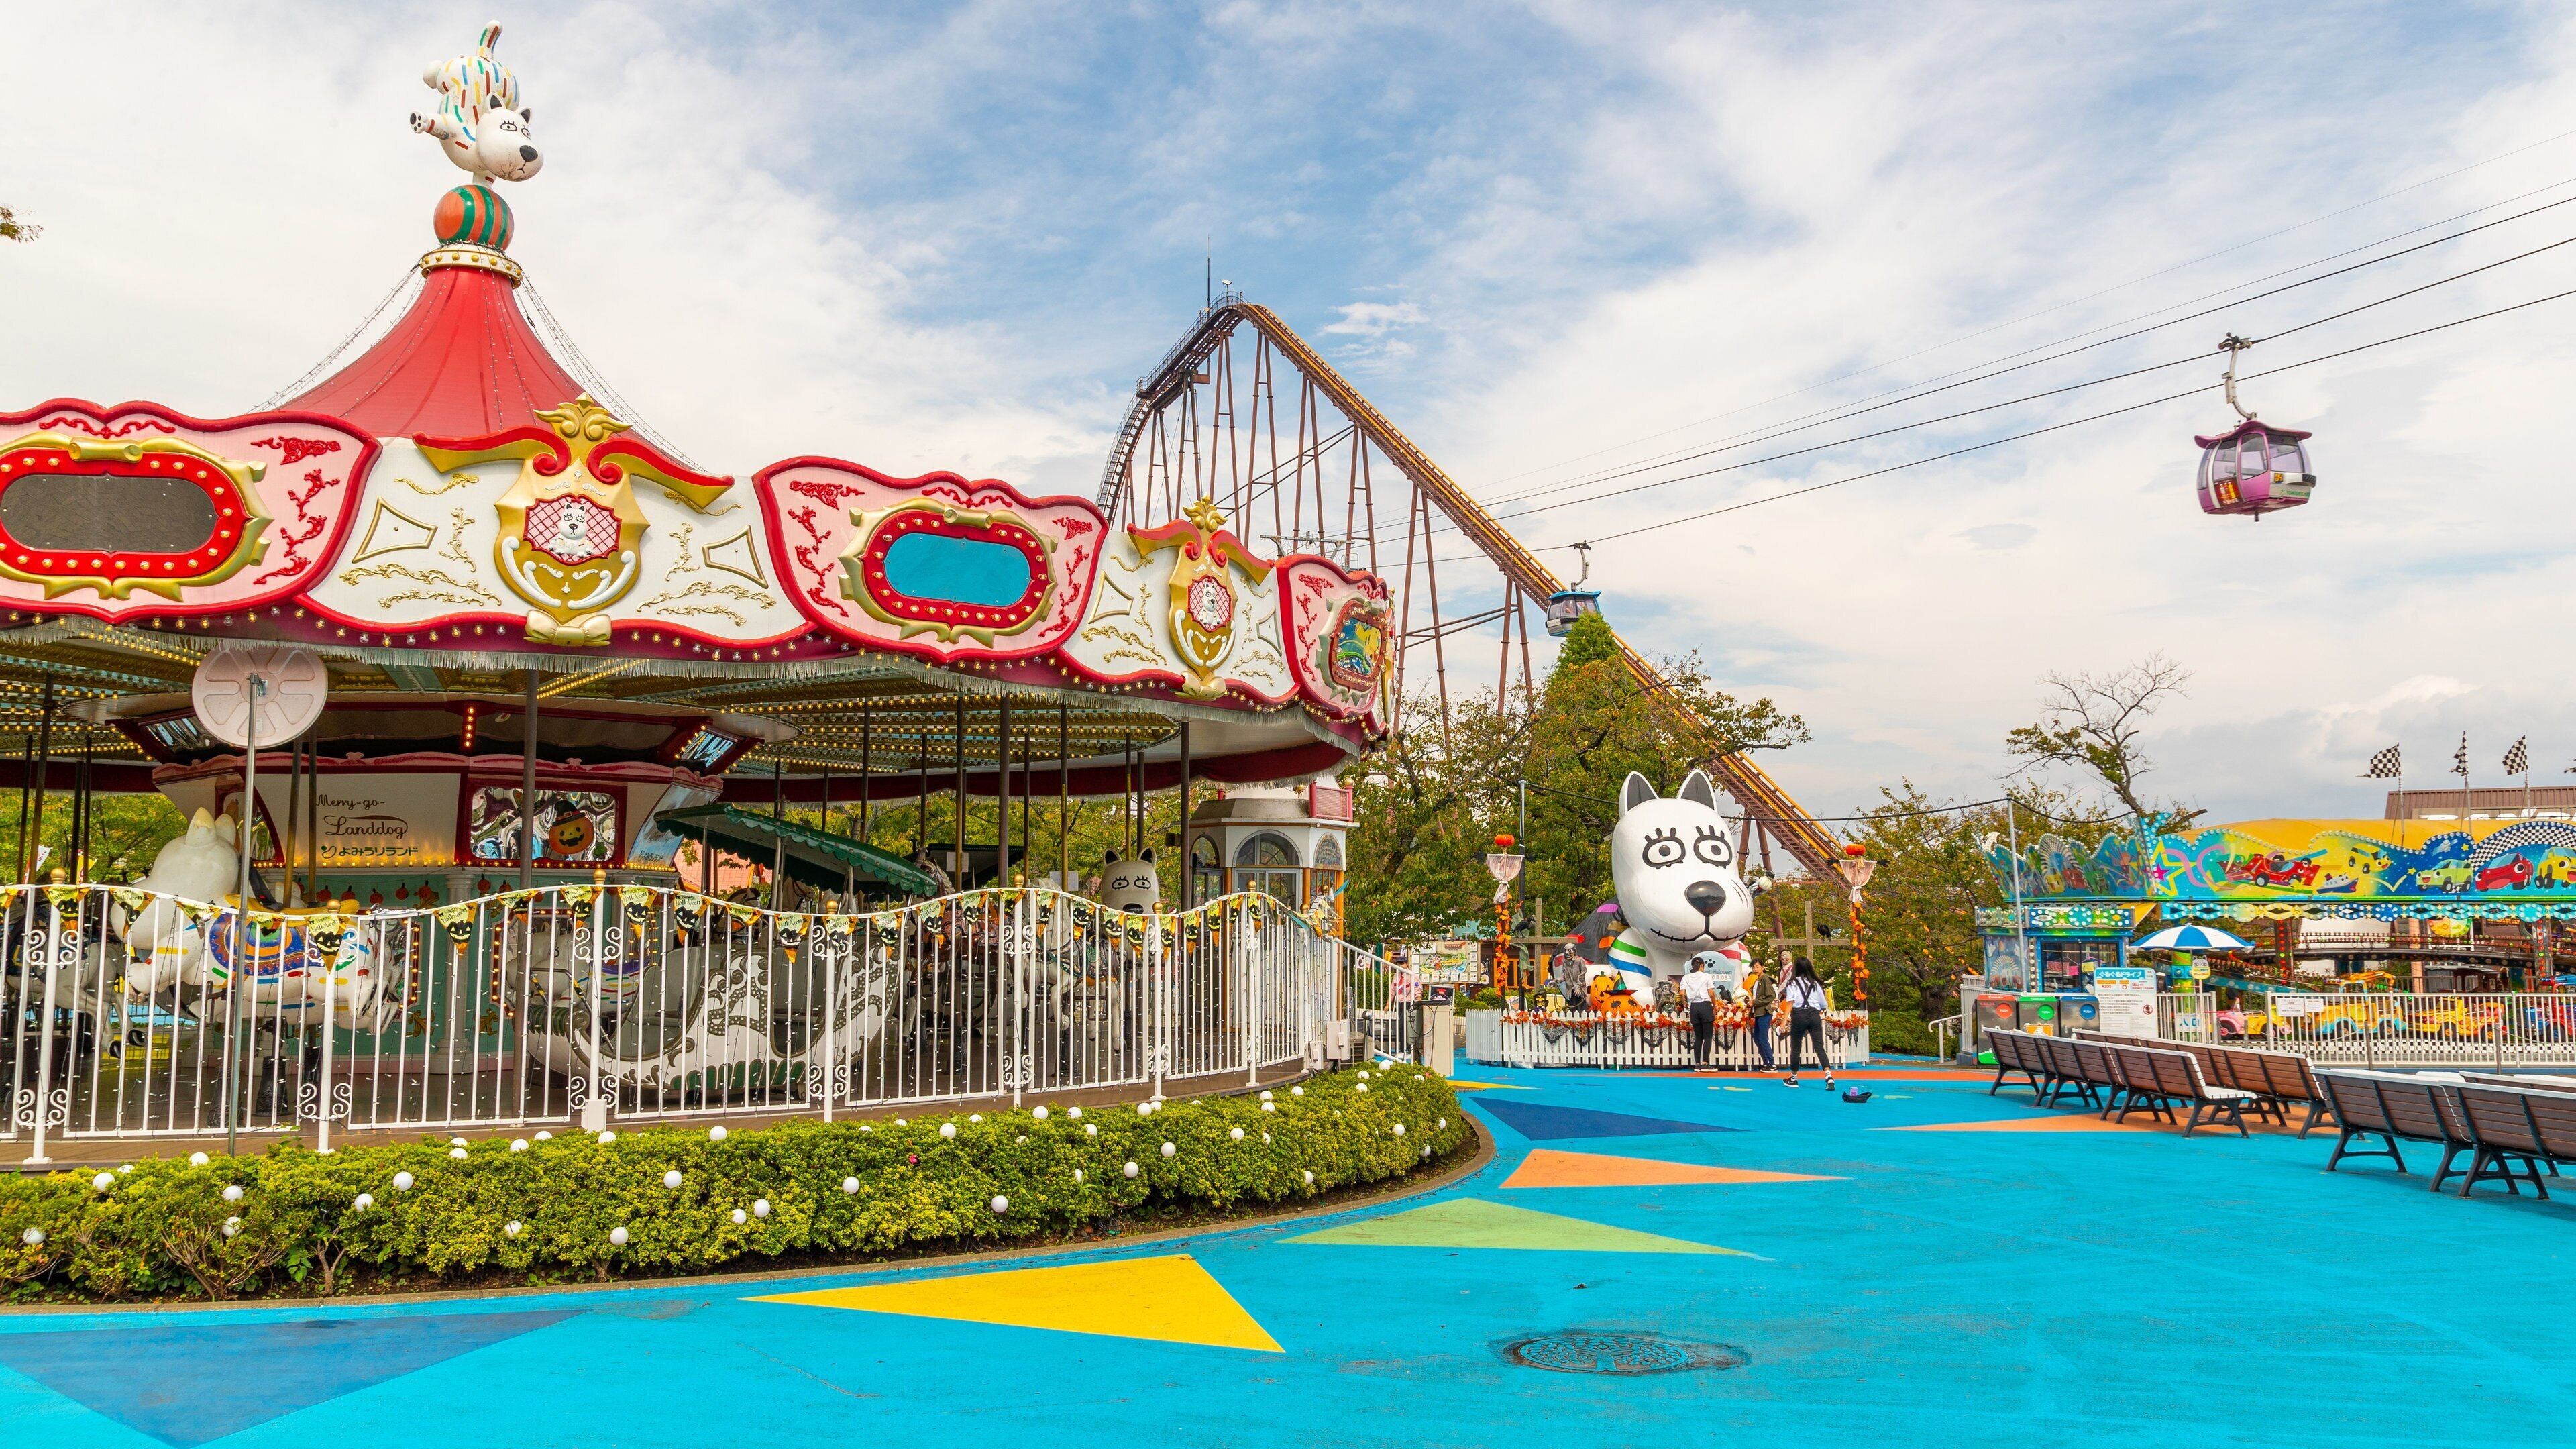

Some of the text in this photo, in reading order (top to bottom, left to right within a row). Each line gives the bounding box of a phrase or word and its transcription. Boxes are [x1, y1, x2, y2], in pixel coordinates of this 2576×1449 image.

[323, 815, 408, 839] Landdog
[339, 847, 418, 857] よみうりランド
